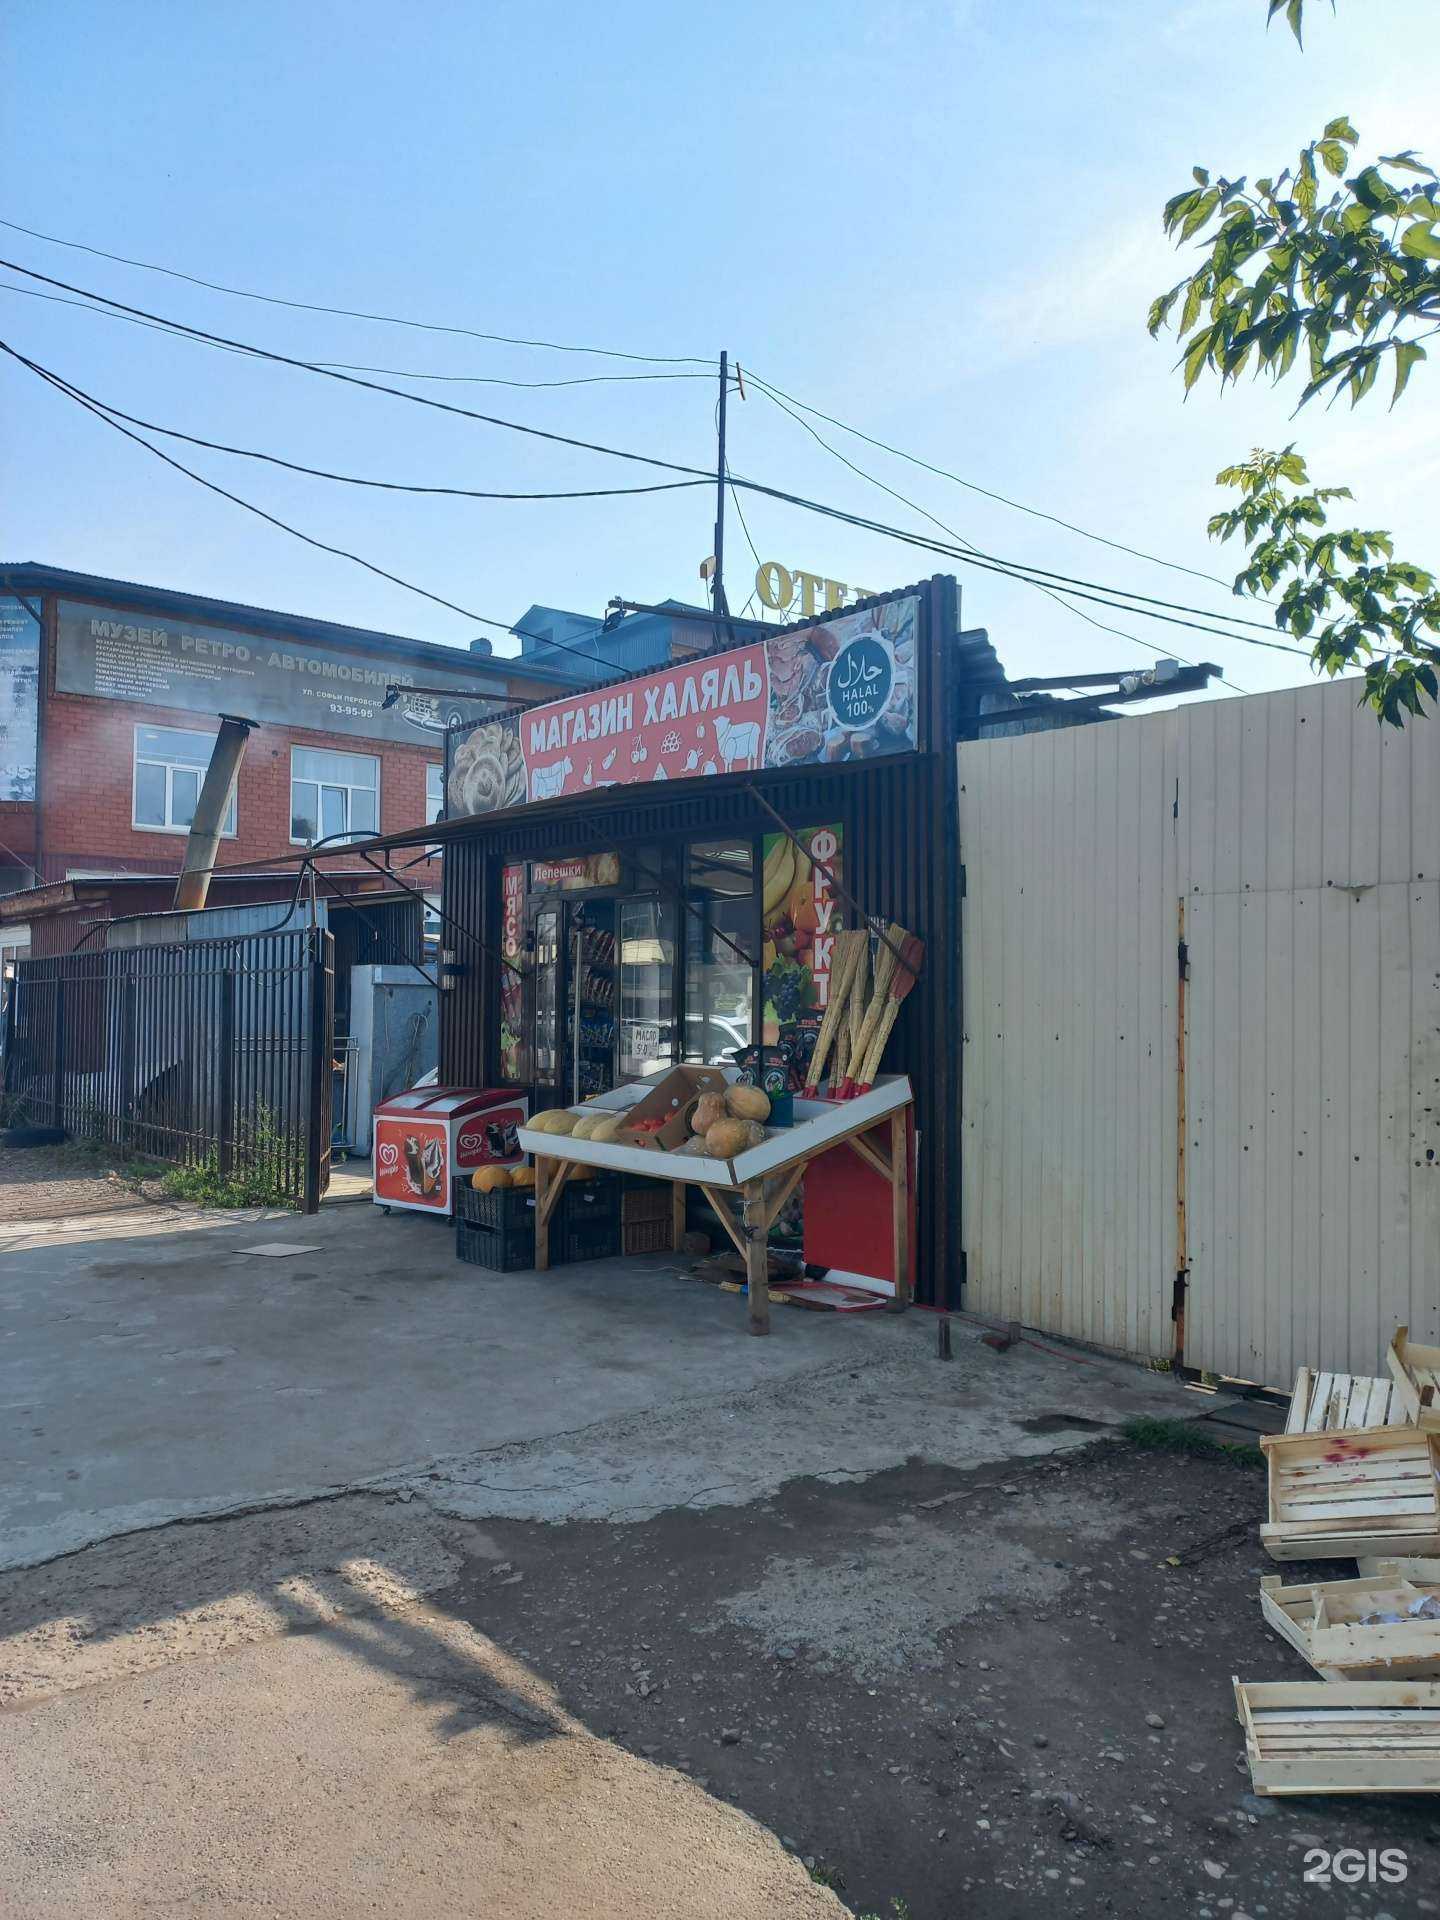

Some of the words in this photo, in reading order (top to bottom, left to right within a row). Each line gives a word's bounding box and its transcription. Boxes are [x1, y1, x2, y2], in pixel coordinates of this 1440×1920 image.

[90, 619, 168, 648] МУЗЕЙ
[181, 634, 250, 662] РЕТРО
[267, 652, 415, 687] АВТОМОБИЛЕЙ
[837, 652, 883, 688] حلال
[842, 683, 879, 702] HALAL
[329, 703, 373, 719] 93-95-95
[530, 693, 633, 755] МАГАЗИН
[643, 659, 763, 727] ХАЛЯЛЬ
[846, 700, 875, 718] 100%
[535, 864, 581, 881] Лепешки
[505, 874, 518, 958] МЯСО
